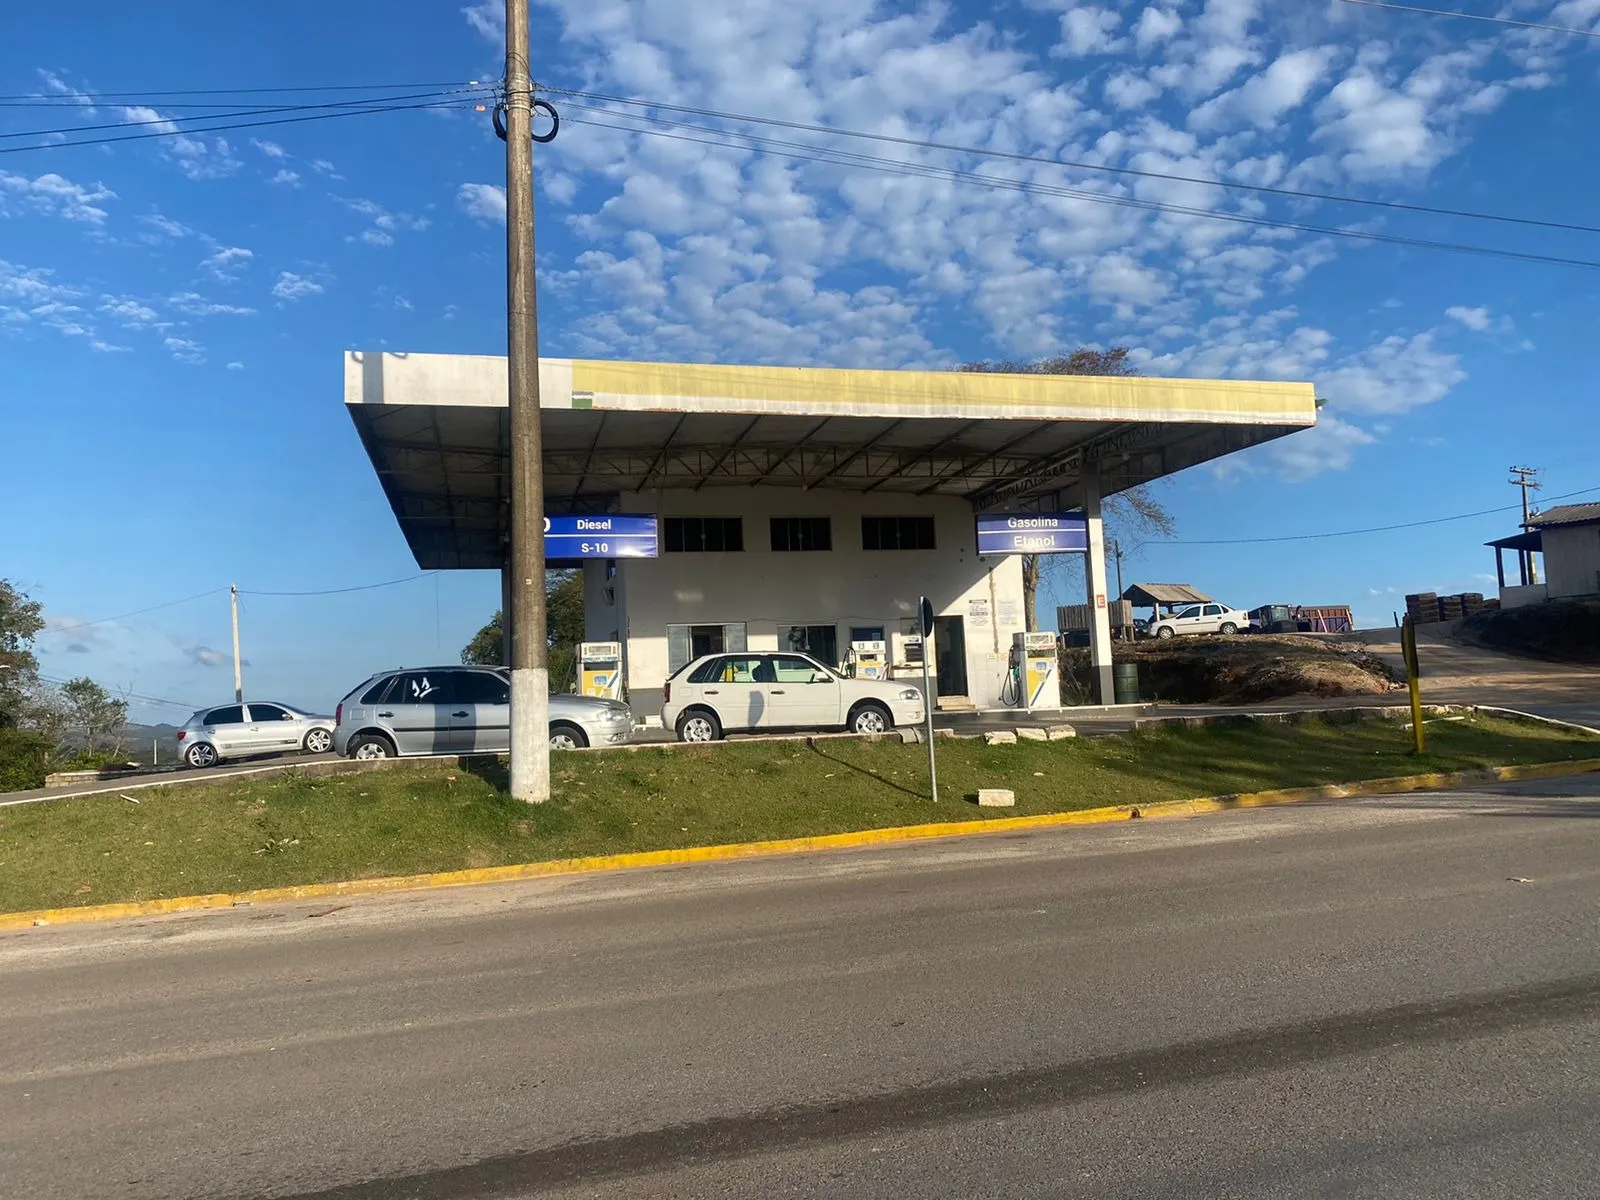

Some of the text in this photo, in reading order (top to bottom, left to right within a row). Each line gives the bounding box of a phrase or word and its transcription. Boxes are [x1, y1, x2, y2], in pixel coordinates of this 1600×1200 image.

[576, 518, 612, 530] Diesel
[1007, 516, 1059, 529] Gasolina
[1013, 535, 1056, 547] Etanol
[581, 542, 609, 553] S-10
